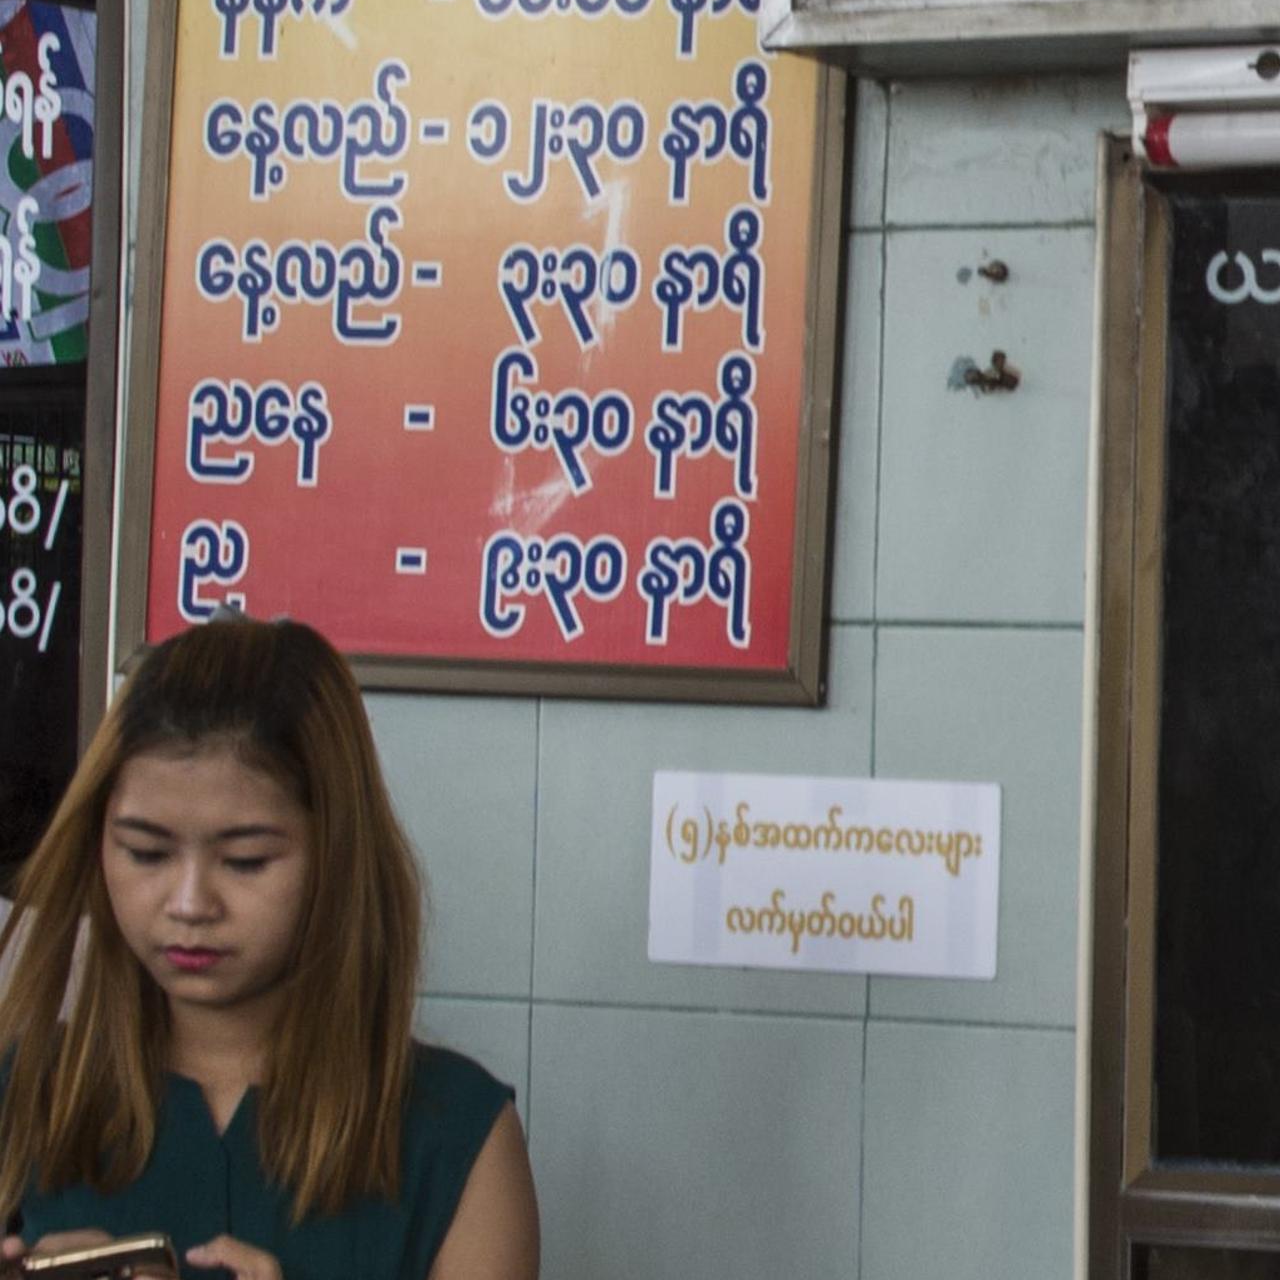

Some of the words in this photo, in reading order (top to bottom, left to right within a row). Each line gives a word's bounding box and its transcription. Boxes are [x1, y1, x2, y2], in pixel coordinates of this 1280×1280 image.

[661, 58, 771, 201] နာရီ
[653, 208, 764, 352] နာရီ
[186, 379, 331, 487] ညနေ
[645, 355, 756, 498] နာရီ
[638, 498, 751, 648] နာရီ
